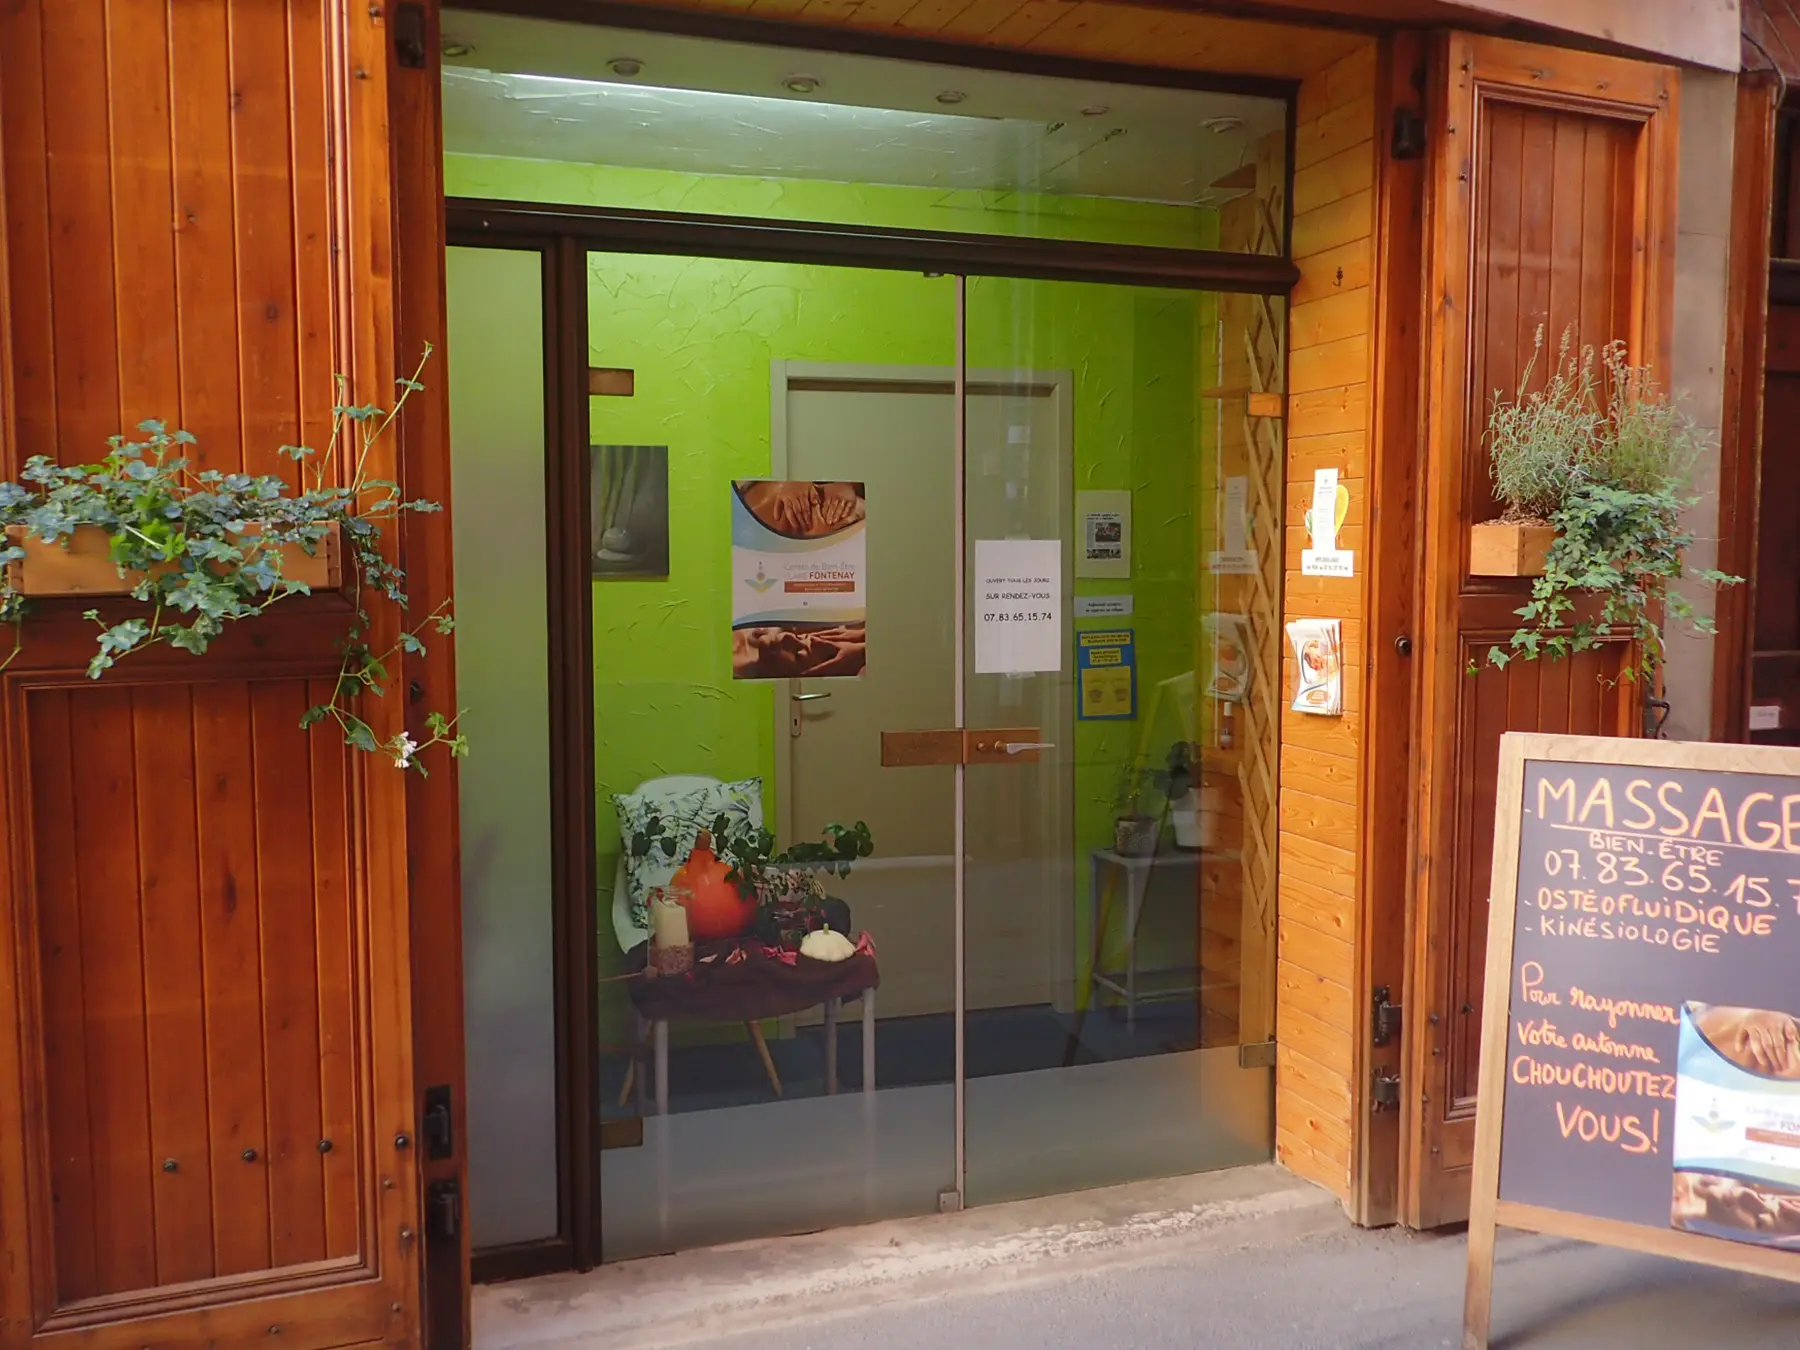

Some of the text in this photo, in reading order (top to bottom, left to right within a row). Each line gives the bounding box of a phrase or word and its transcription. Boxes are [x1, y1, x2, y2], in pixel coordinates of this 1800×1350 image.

[809, 571, 855, 580] FONTENAY
[985, 592, 1051, 600] SUR RENDEZ-VOUS
[983, 612, 1052, 622] 07.83.65.15.74
[1521, 961, 1680, 1029] Pour rayonner
[1572, 1030, 1661, 1064] automne
[1512, 1055, 1677, 1100] CHOUCHOUTEZ
[1556, 1101, 1660, 1155] VOUS!
